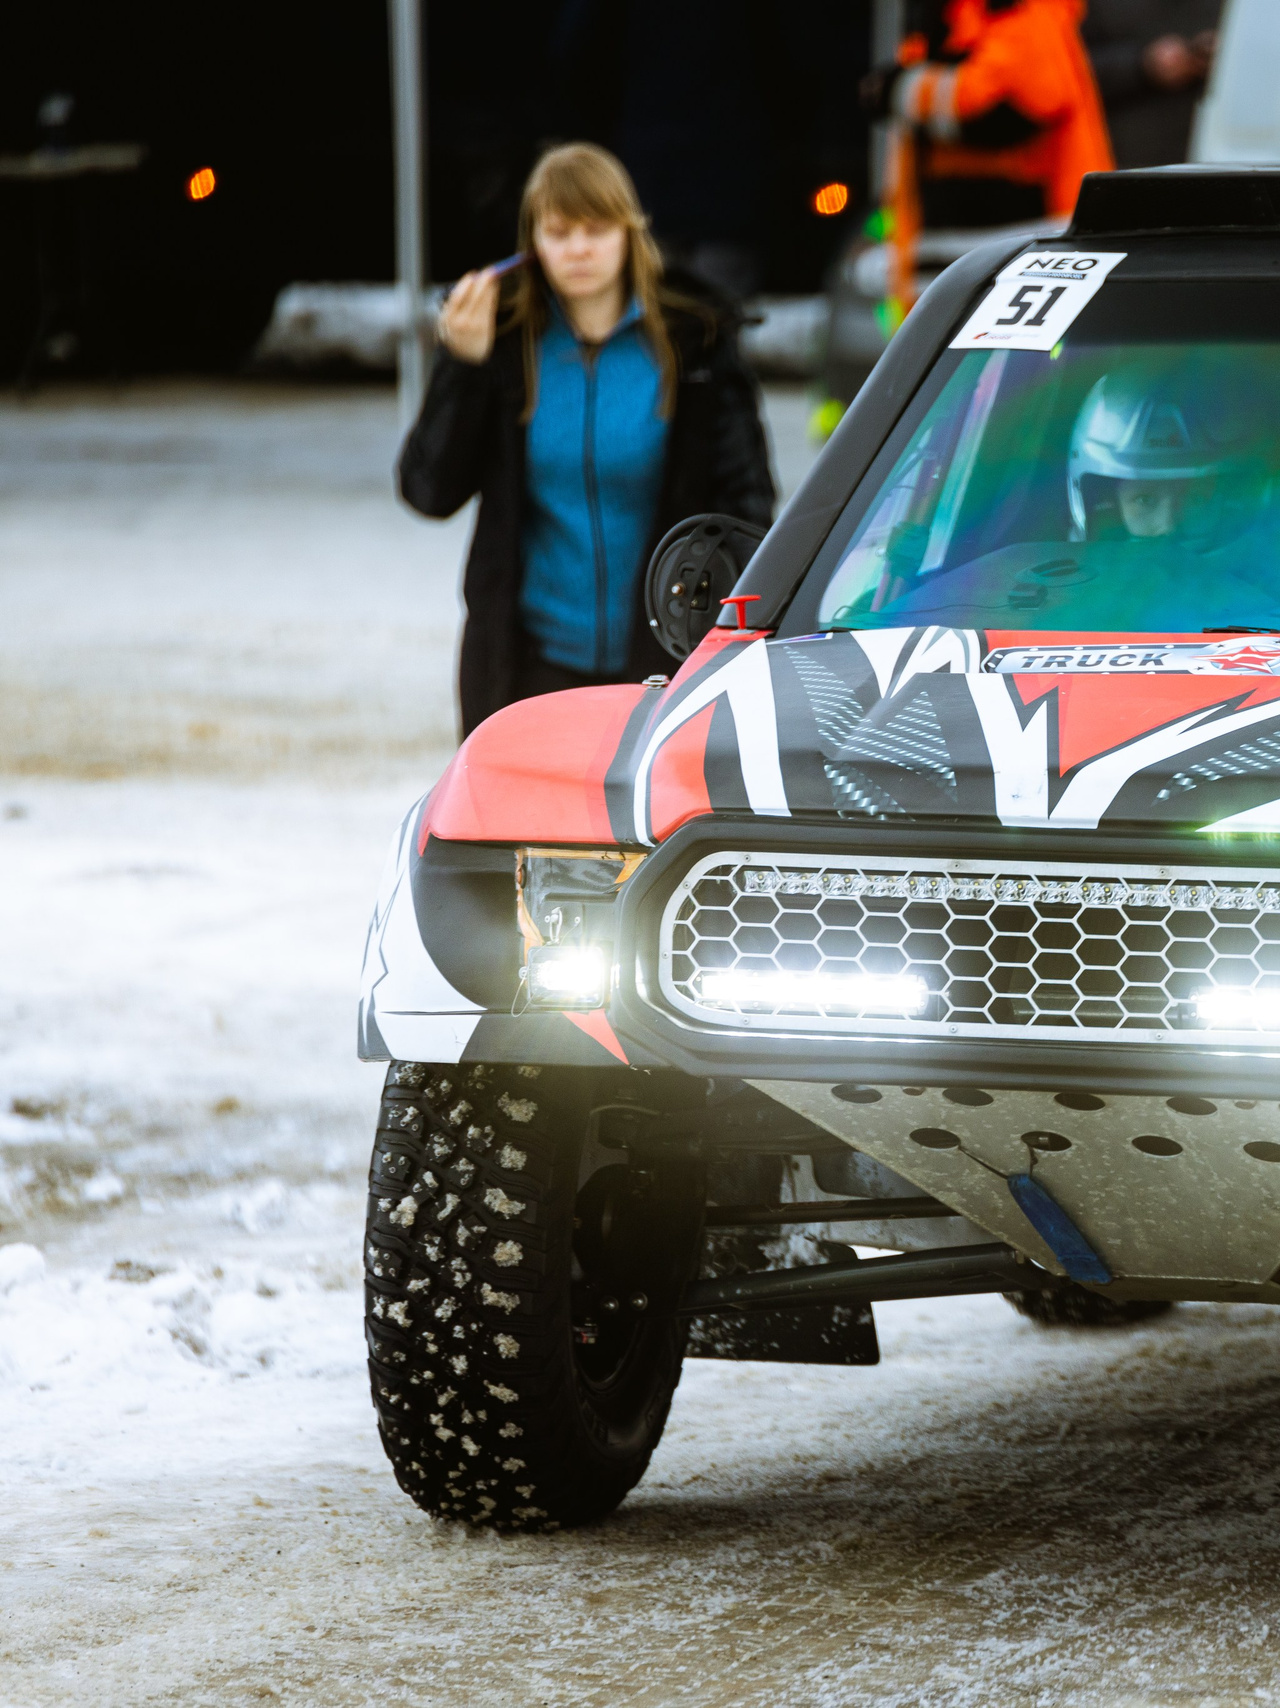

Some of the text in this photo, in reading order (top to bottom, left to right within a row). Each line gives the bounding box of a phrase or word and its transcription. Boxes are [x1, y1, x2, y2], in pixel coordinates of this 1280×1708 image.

[1026, 257, 1100, 271] NEO
[995, 285, 1069, 327] 51
[1019, 652, 1173, 670] TRUCK
